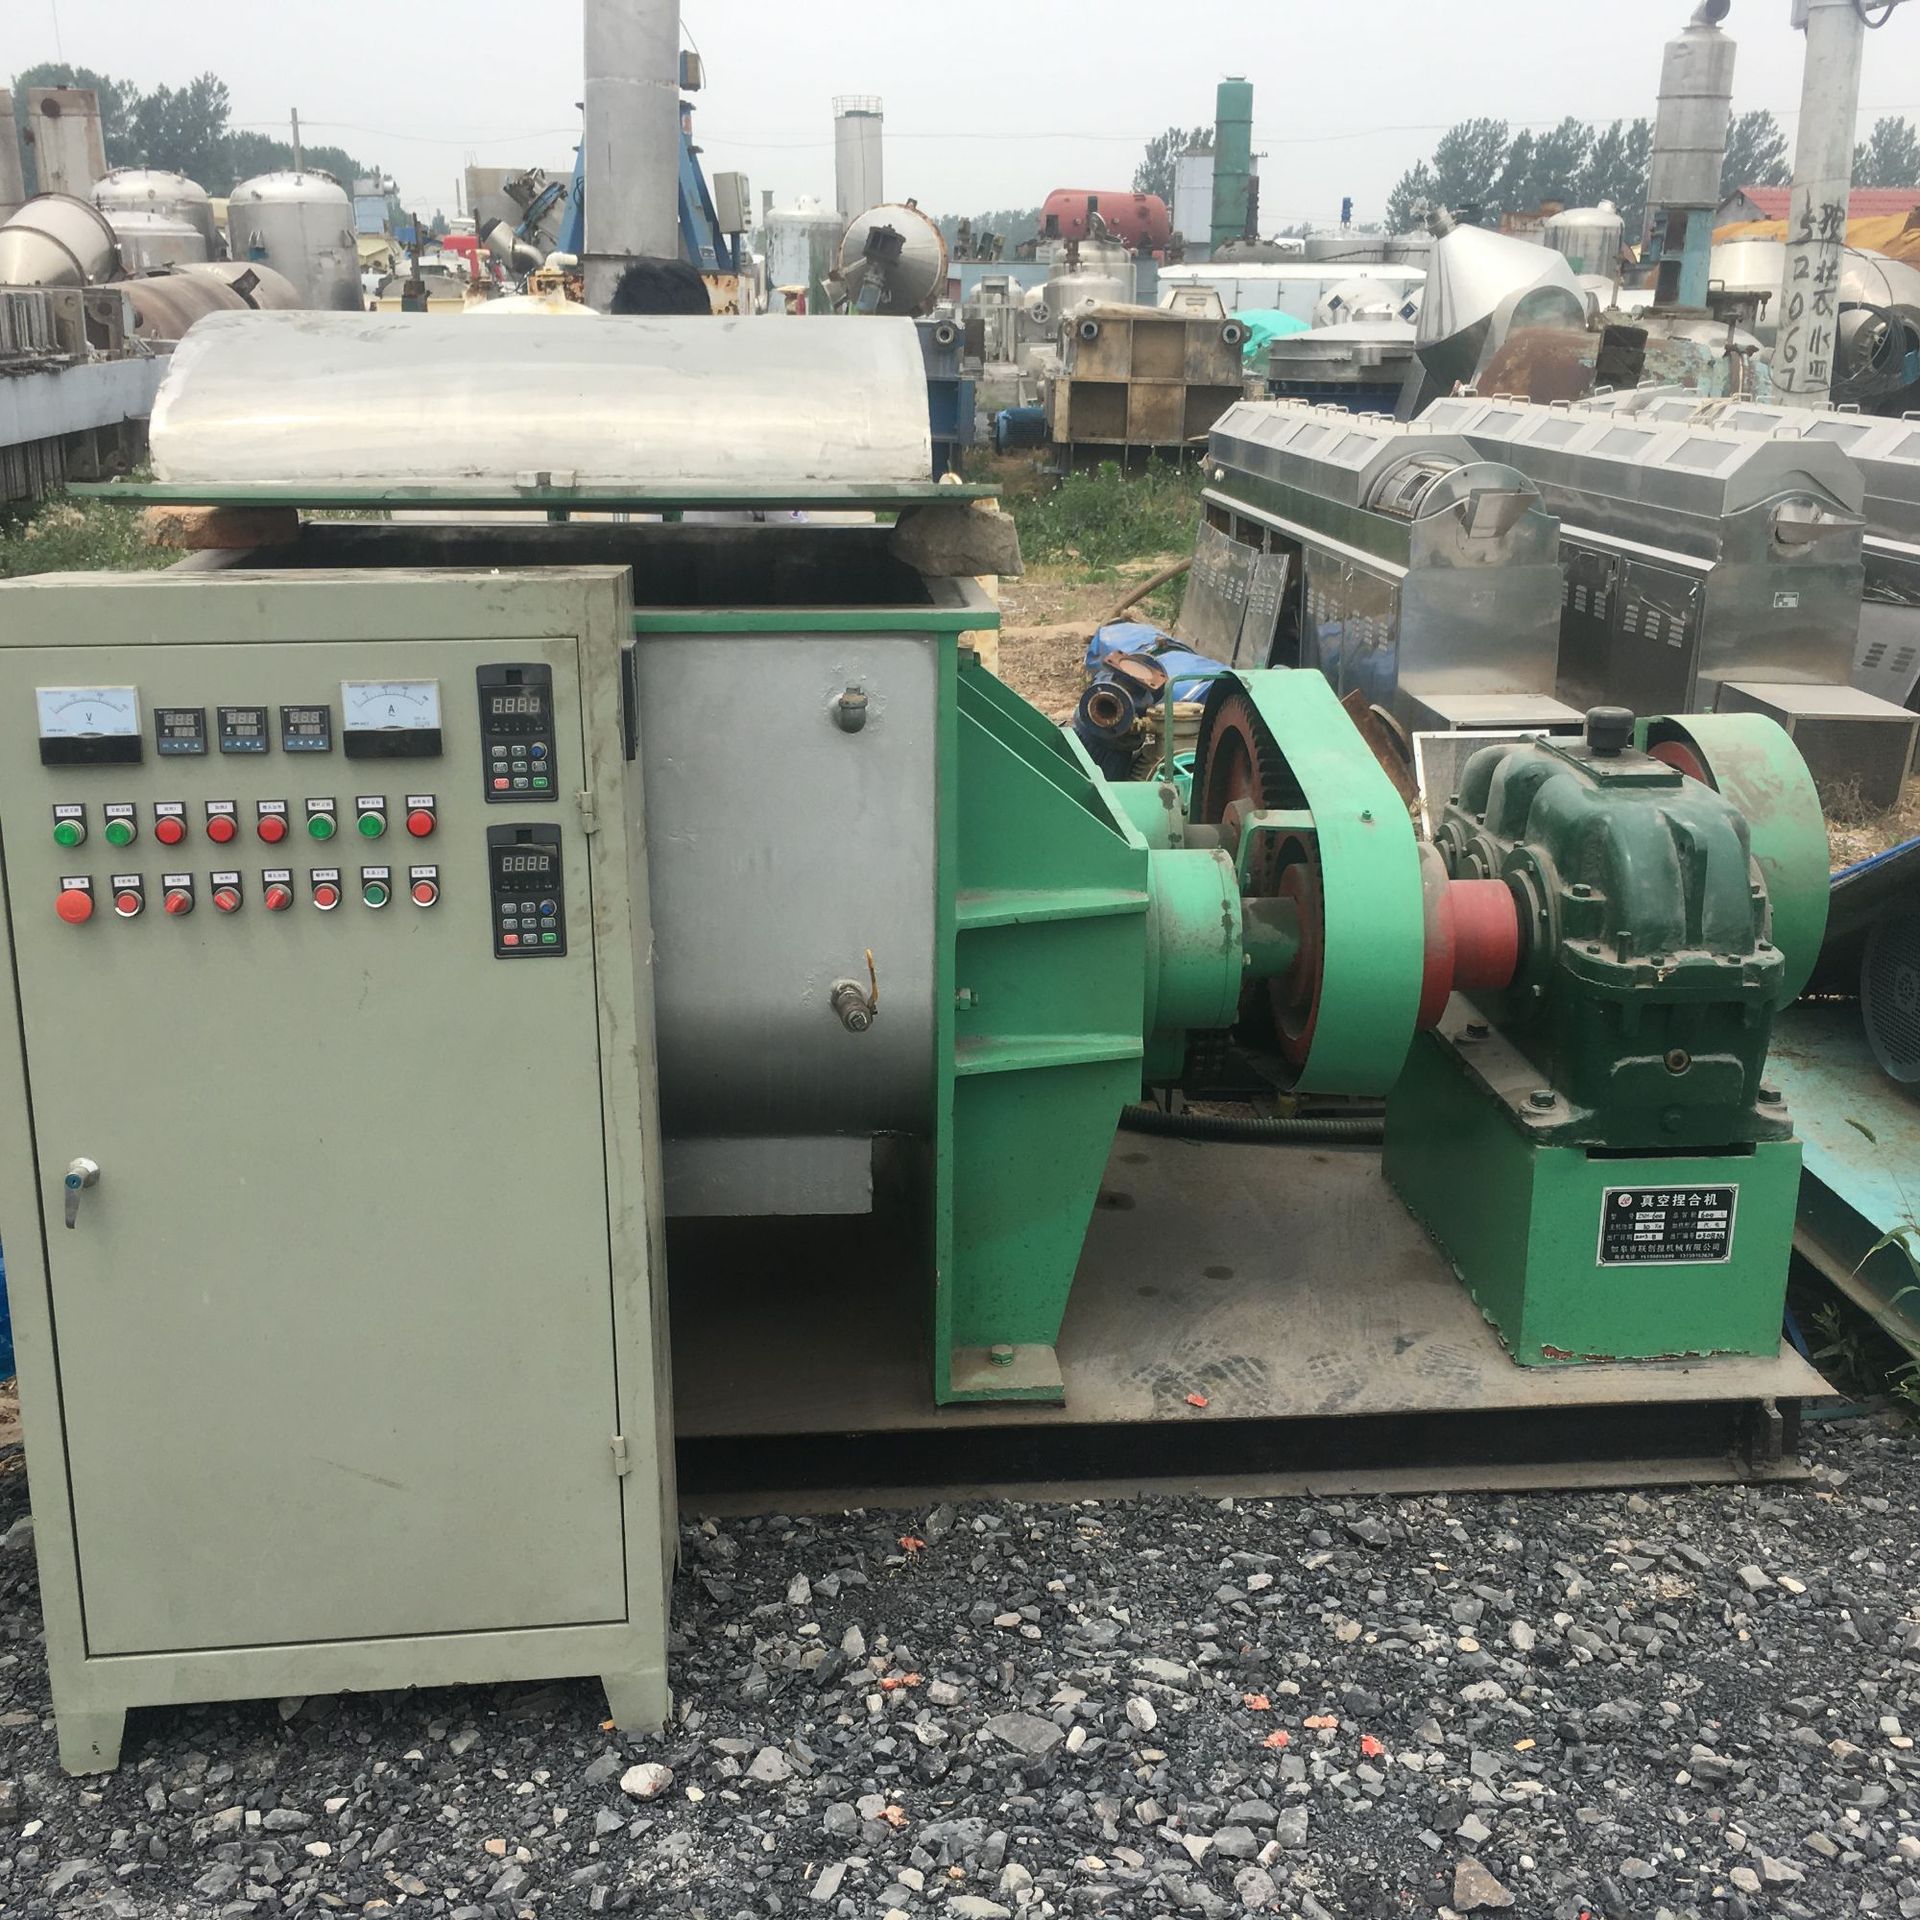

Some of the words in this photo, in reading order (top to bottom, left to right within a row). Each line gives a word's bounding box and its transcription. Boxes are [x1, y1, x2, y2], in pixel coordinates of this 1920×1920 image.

[1640, 1193, 1718, 1207] 真空捏合机
